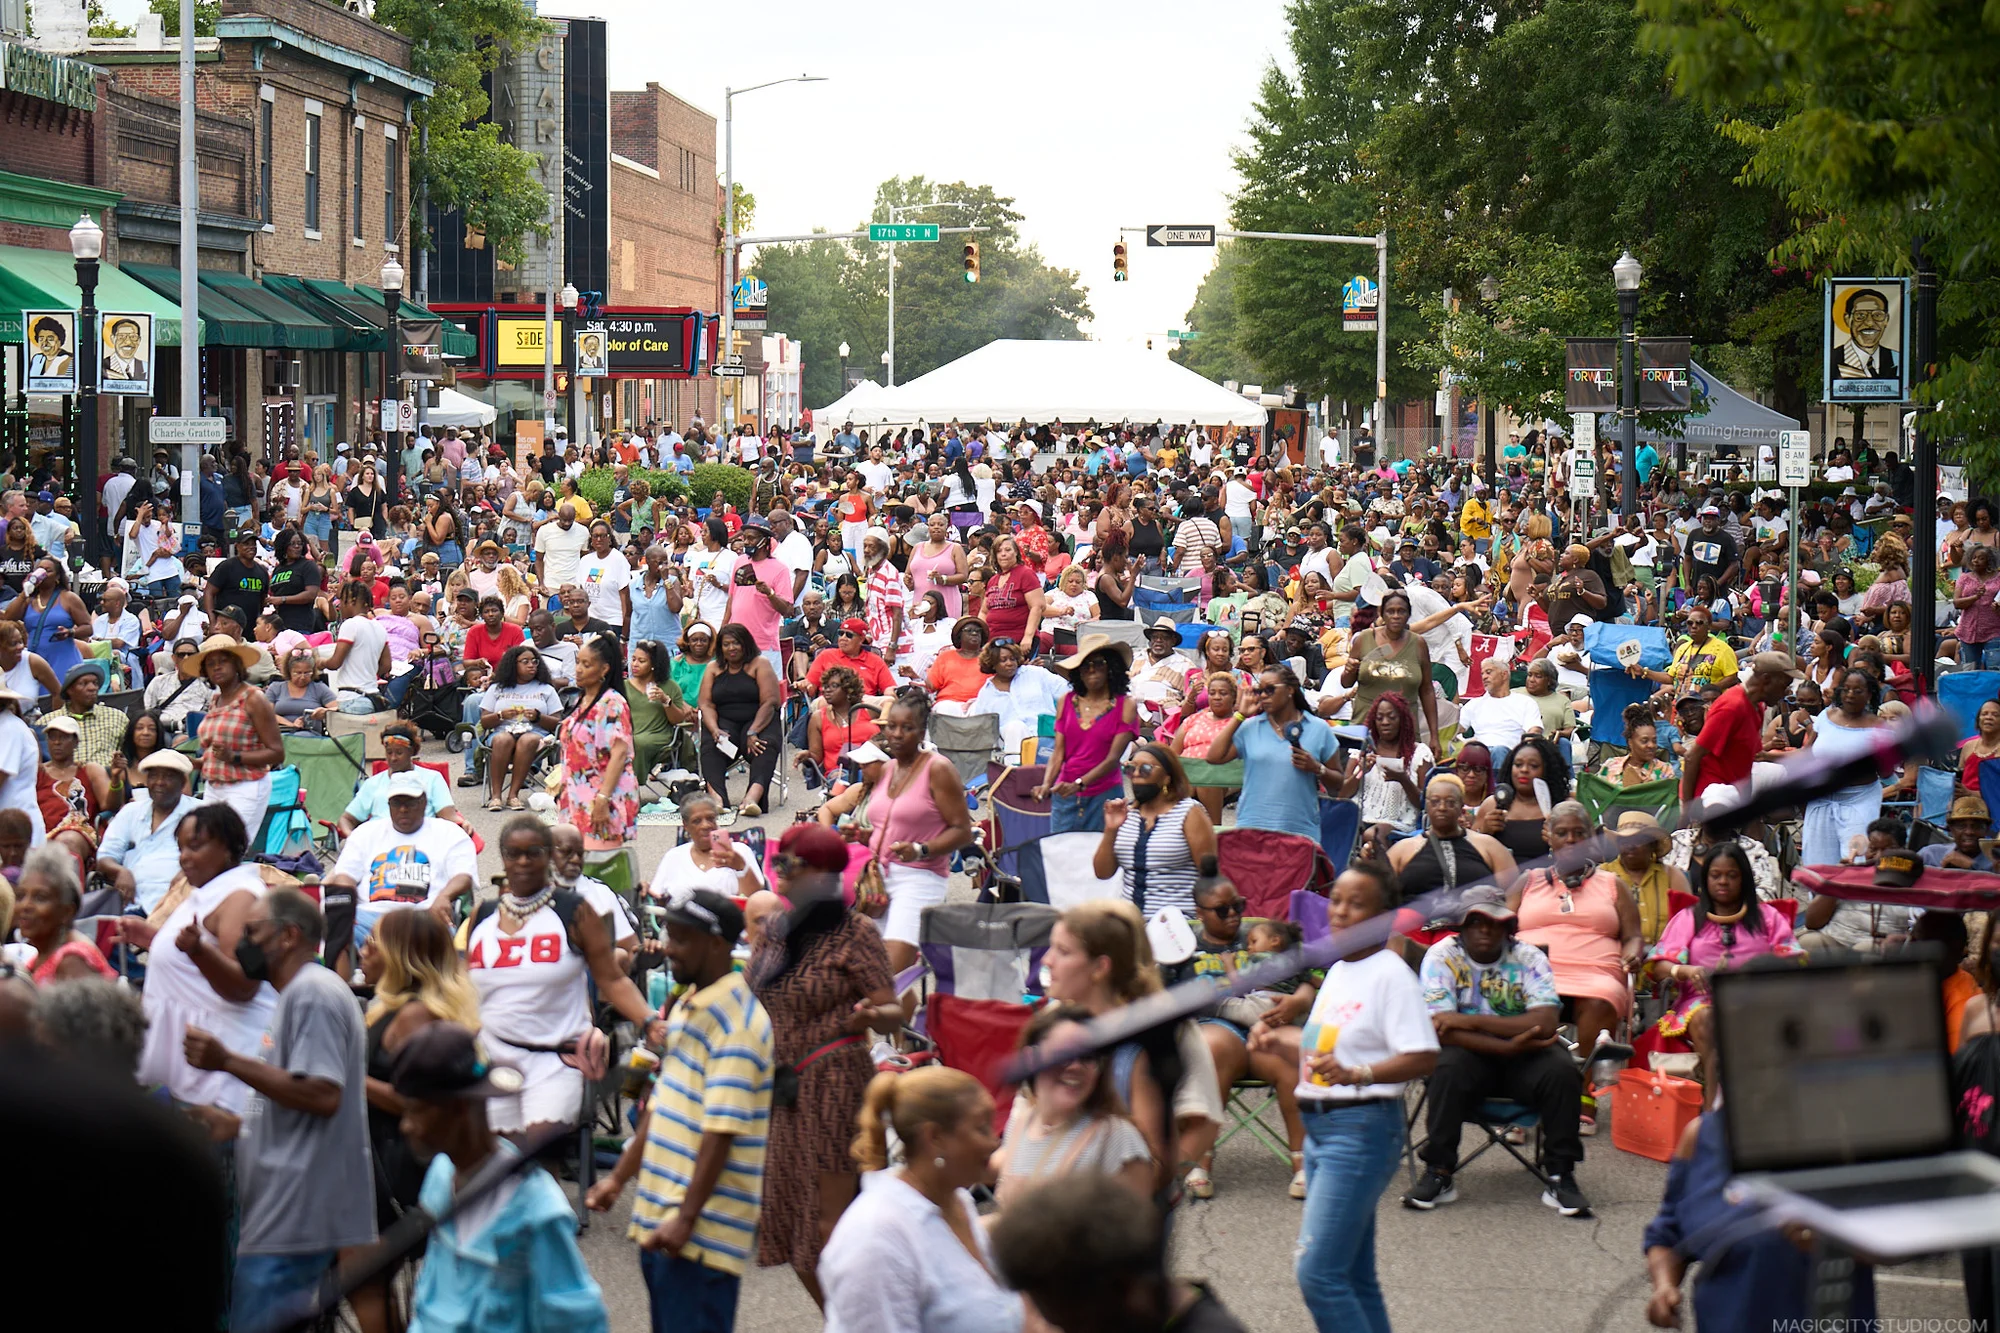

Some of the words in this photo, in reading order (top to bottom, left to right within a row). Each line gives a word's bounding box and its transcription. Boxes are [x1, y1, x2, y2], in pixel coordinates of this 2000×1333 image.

[878, 228, 897, 237] 17th
[905, 228, 916, 237] St
[924, 228, 931, 238] N
[1167, 231, 1184, 240] ONE
[1188, 231, 1207, 240] WAY
[0, 321, 22, 333] EEN
[609, 321, 632, 332] 4:30
[634, 322, 657, 333] p.m.
[607, 339, 627, 352] olor
[629, 339, 641, 352] of
[643, 339, 669, 352] Care
[1838, 384, 1864, 393] CHARLES
[1866, 384, 1892, 393] GRATTON
[154, 428, 185, 438] Charles
[187, 428, 220, 438] Gratton
[1782, 434, 1789, 447] 2
[1785, 451, 1790, 459] 8
[1793, 451, 1805, 459] AM
[1785, 466, 1790, 474] 6
[1793, 466, 1804, 474] PM
